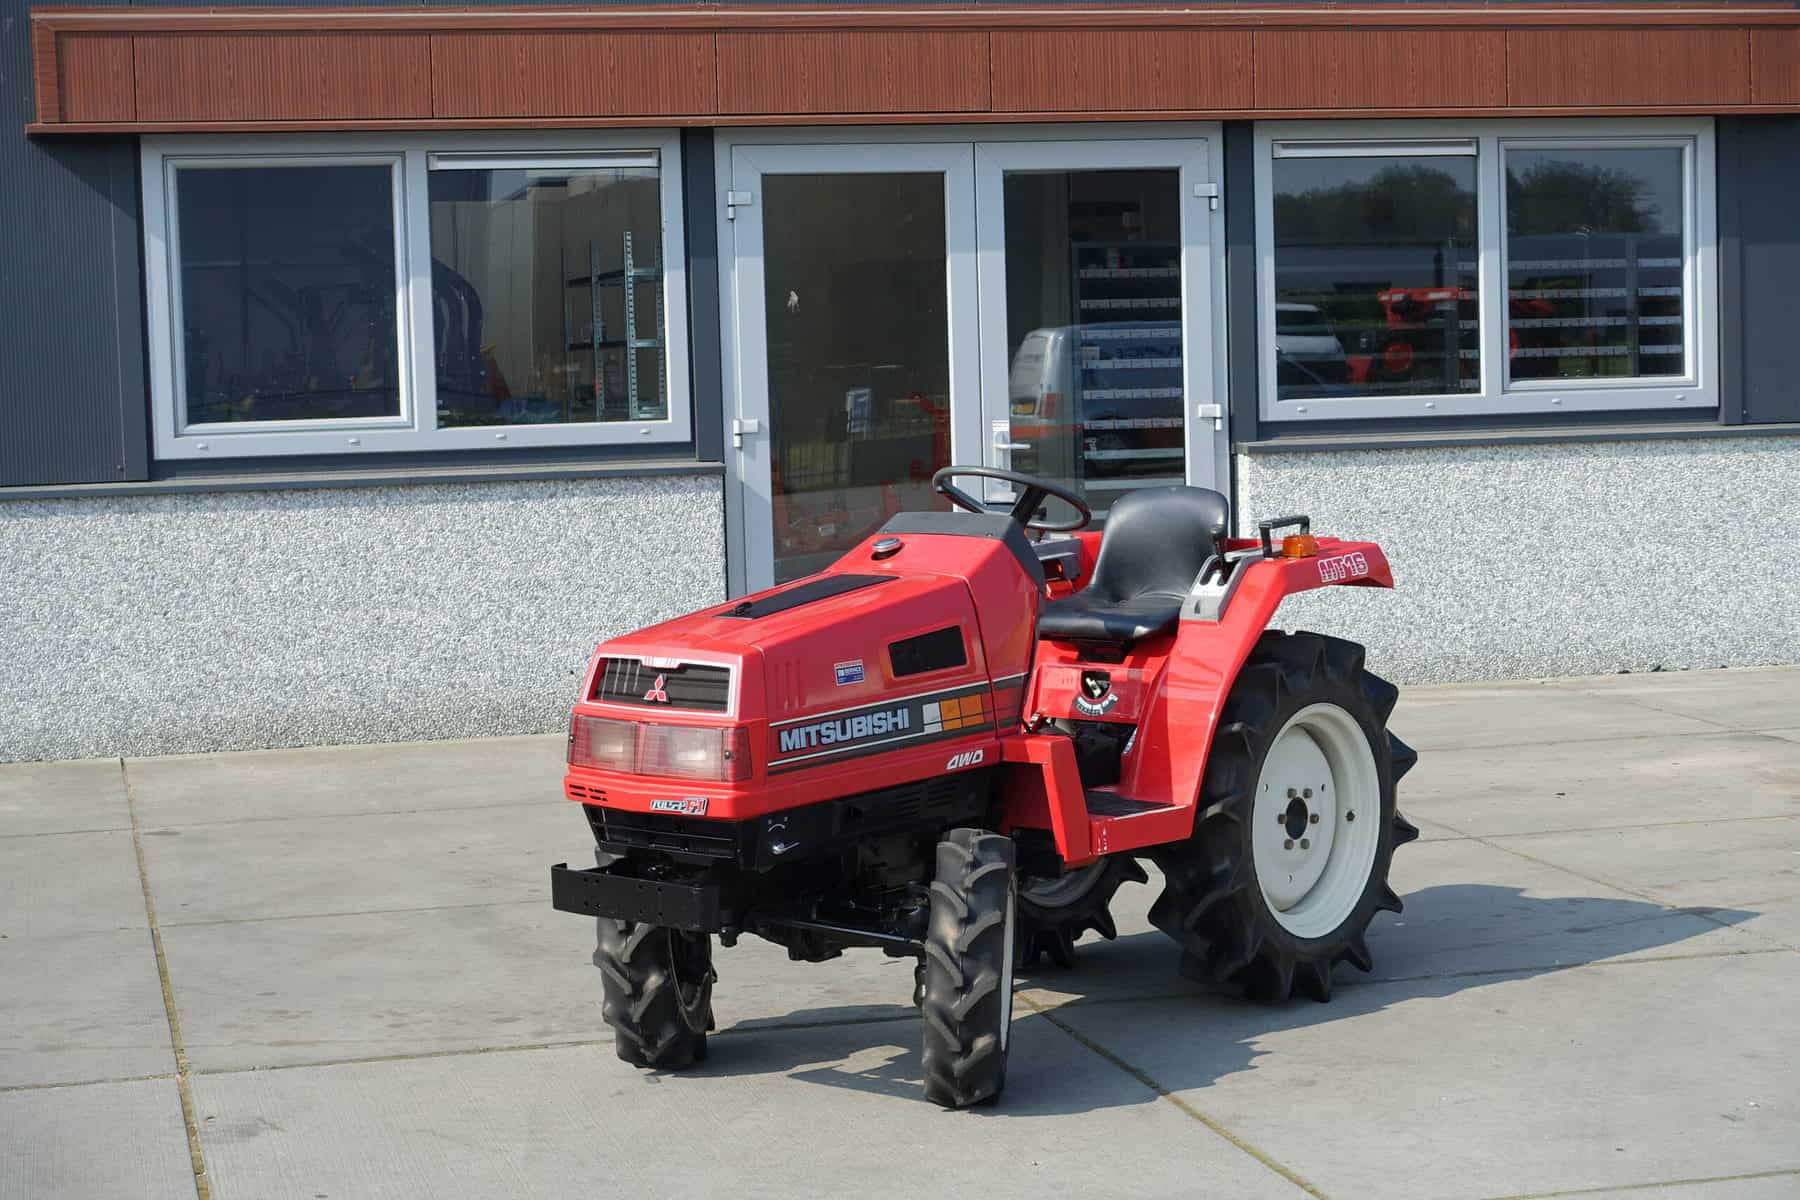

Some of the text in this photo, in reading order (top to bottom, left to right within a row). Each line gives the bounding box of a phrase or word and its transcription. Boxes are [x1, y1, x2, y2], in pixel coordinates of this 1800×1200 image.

[1318, 552, 1368, 582] MT16
[780, 707, 910, 752] MITSUBISHI
[946, 749, 983, 770] 4WD
